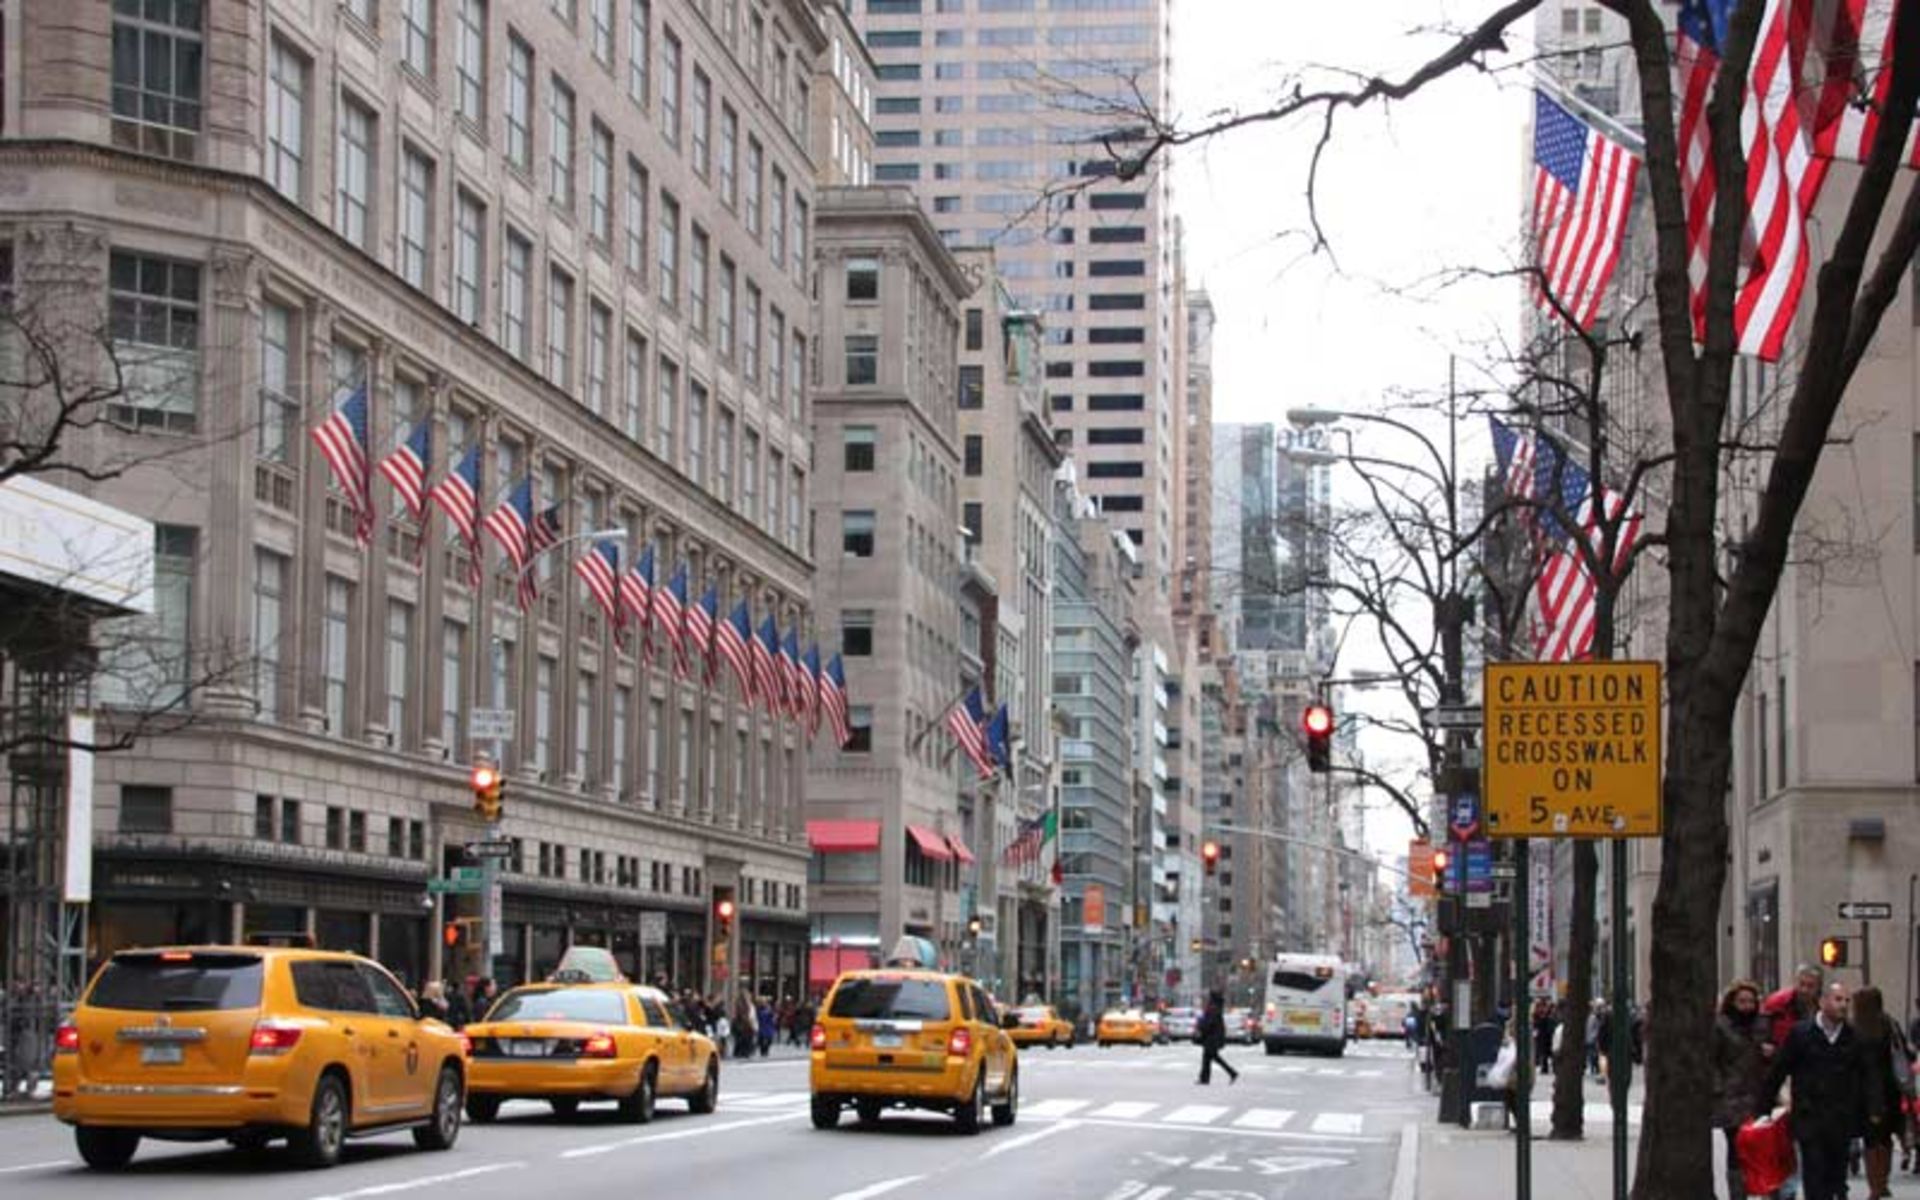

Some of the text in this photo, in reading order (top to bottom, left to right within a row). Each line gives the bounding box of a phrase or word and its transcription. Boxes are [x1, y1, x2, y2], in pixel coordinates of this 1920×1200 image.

[1499, 675, 1643, 702] CAUTION
[1500, 712, 1644, 735] RECESSED
[1497, 741, 1647, 763] CROSSWALK
[1553, 769, 1592, 791] ON
[1530, 796, 1615, 824] 5 AVE
